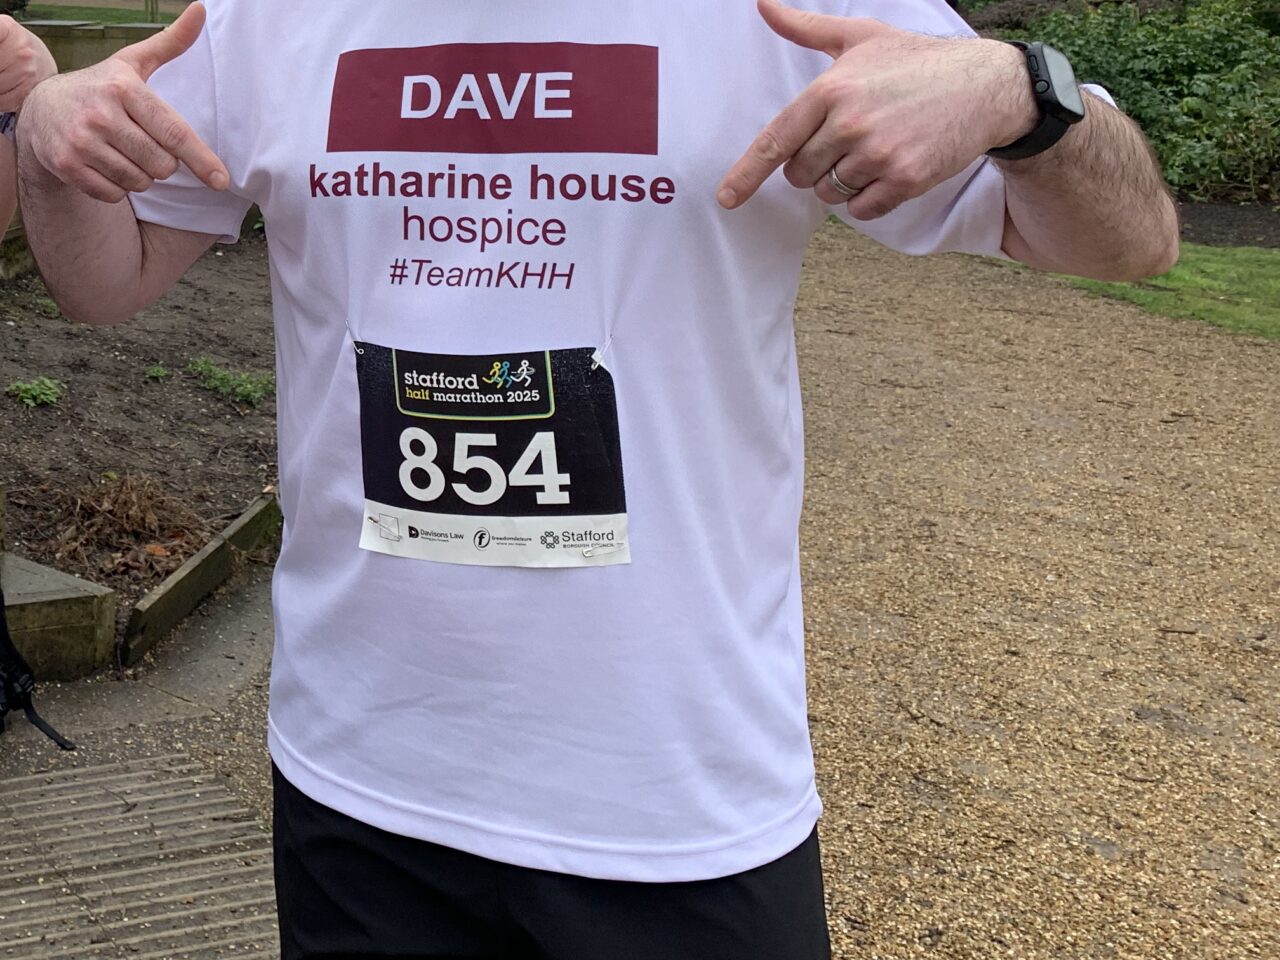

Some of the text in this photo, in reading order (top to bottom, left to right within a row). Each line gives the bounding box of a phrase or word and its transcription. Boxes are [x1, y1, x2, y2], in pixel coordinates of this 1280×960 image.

[400, 71, 573, 119] DAVE
[310, 162, 675, 204] katharine house
[403, 206, 566, 252] hospice
[390, 258, 575, 289] #TeamKHH
[404, 370, 479, 389] stafford
[406, 387, 539, 403] half marathon 2025
[398, 427, 570, 505] 854
[420, 529, 449, 539] Davisons
[562, 530, 615, 542] Stafford
